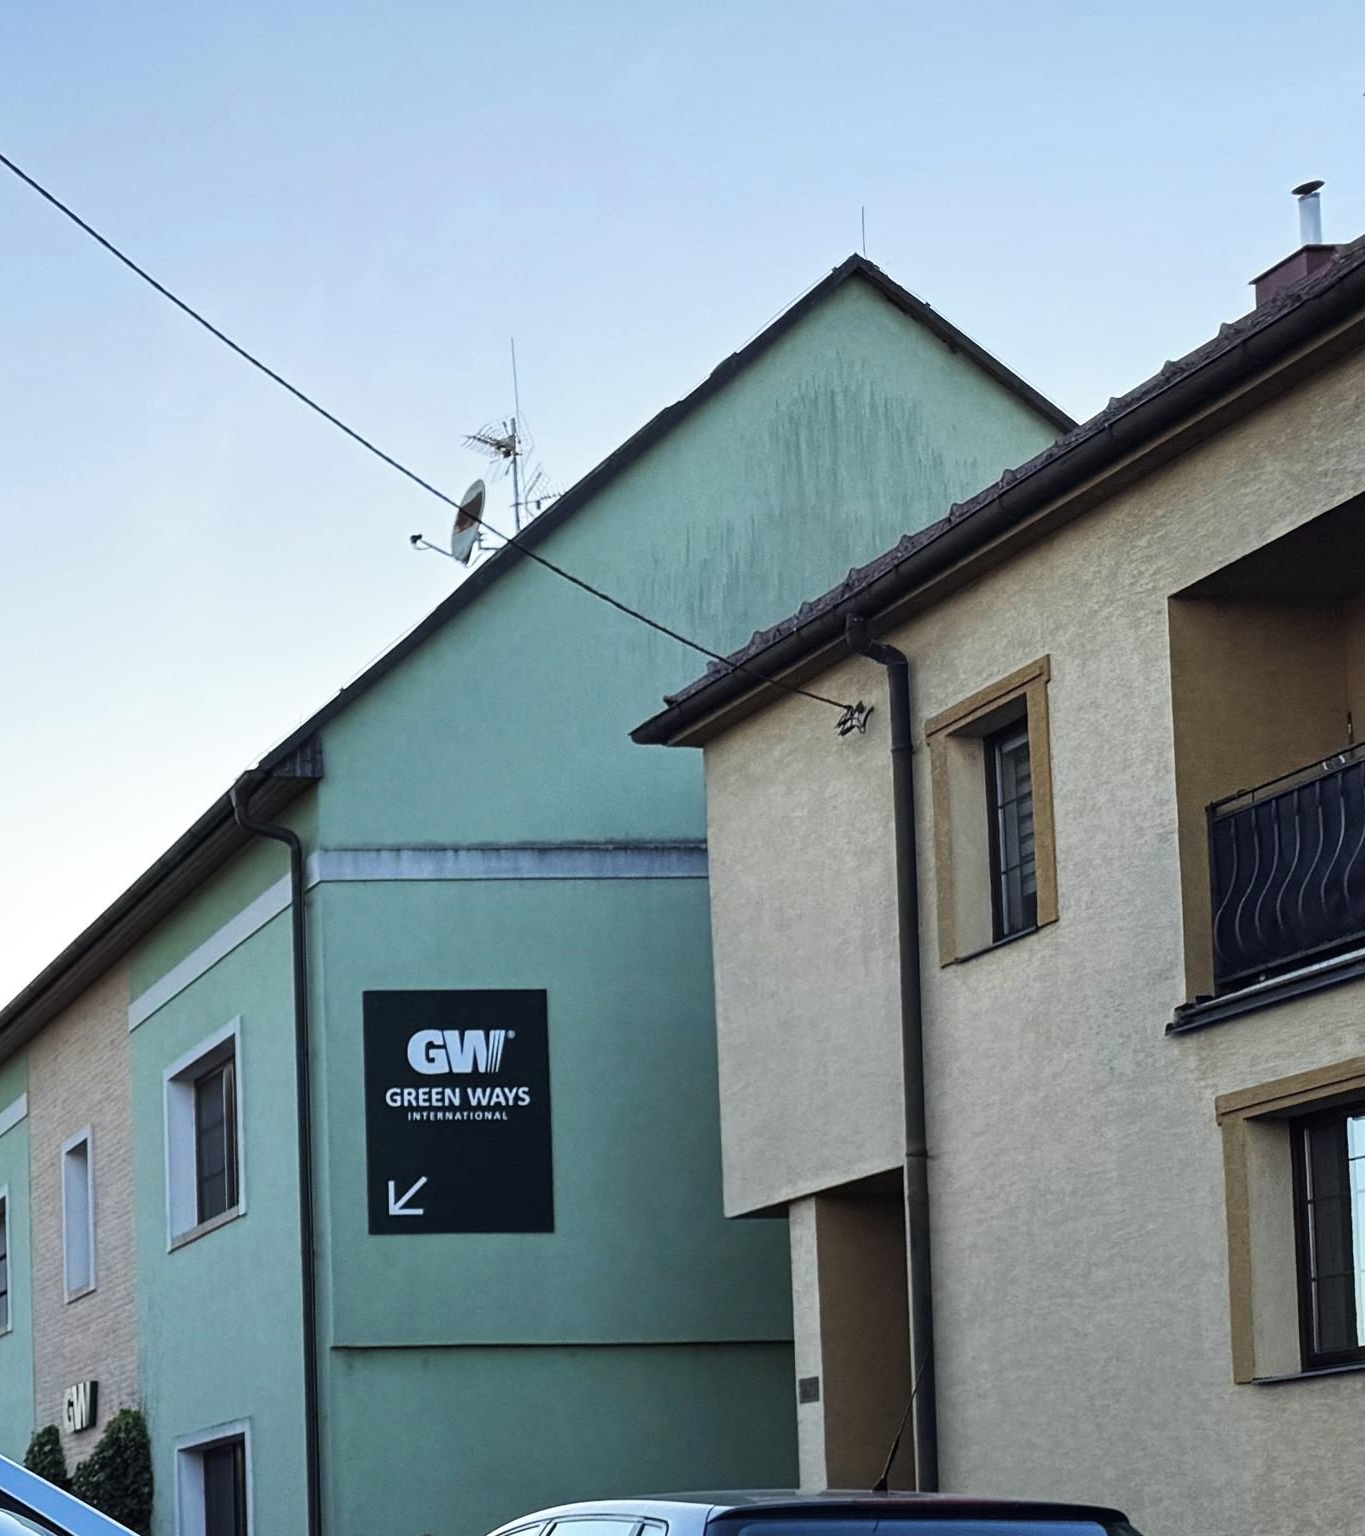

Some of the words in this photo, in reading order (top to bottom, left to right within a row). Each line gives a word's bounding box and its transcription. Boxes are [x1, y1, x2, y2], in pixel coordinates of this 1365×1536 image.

[407, 1029, 506, 1075] GW
[385, 1087, 461, 1107] GREEN
[466, 1086, 531, 1107] WAYS
[407, 1111, 508, 1121] INTERNATIONAL
[63, 1380, 92, 1432] GW
